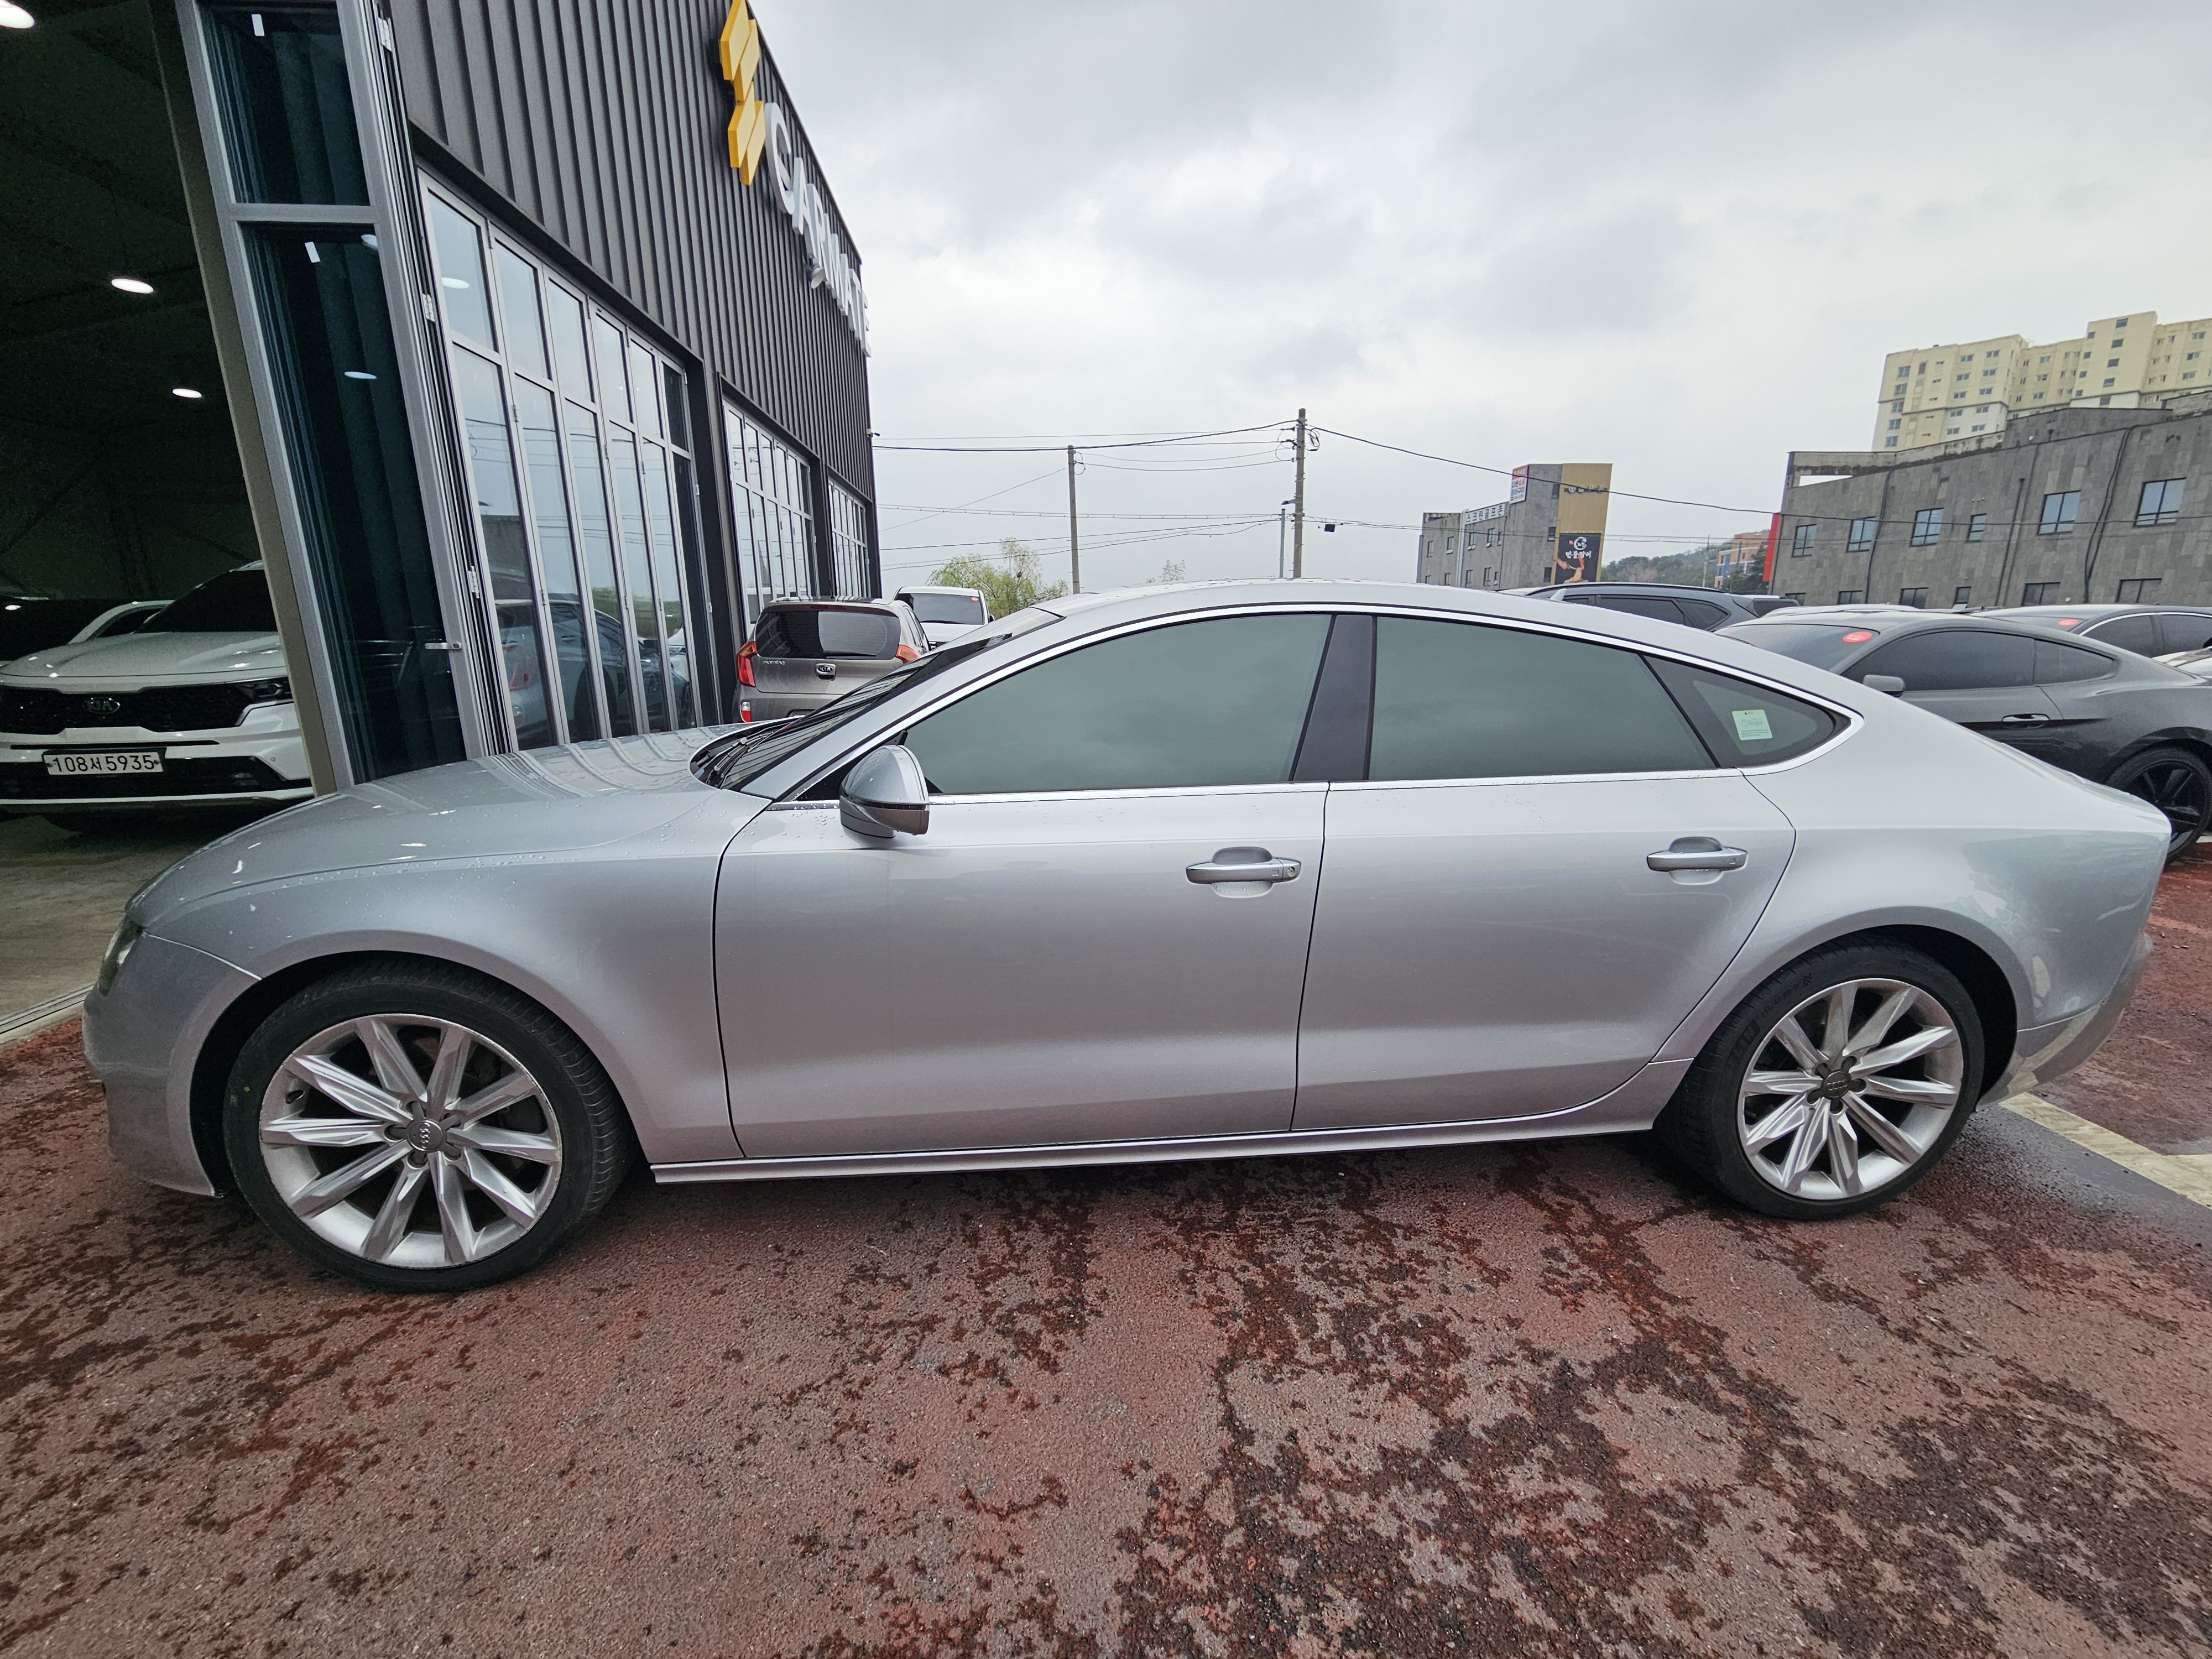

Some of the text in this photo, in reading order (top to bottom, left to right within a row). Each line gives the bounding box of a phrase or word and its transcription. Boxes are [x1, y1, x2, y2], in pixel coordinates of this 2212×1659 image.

[765, 102, 872, 358] CARMATE
[1466, 505, 1503, 523] 스크린골프존
[53, 755, 154, 773] 108서5935
